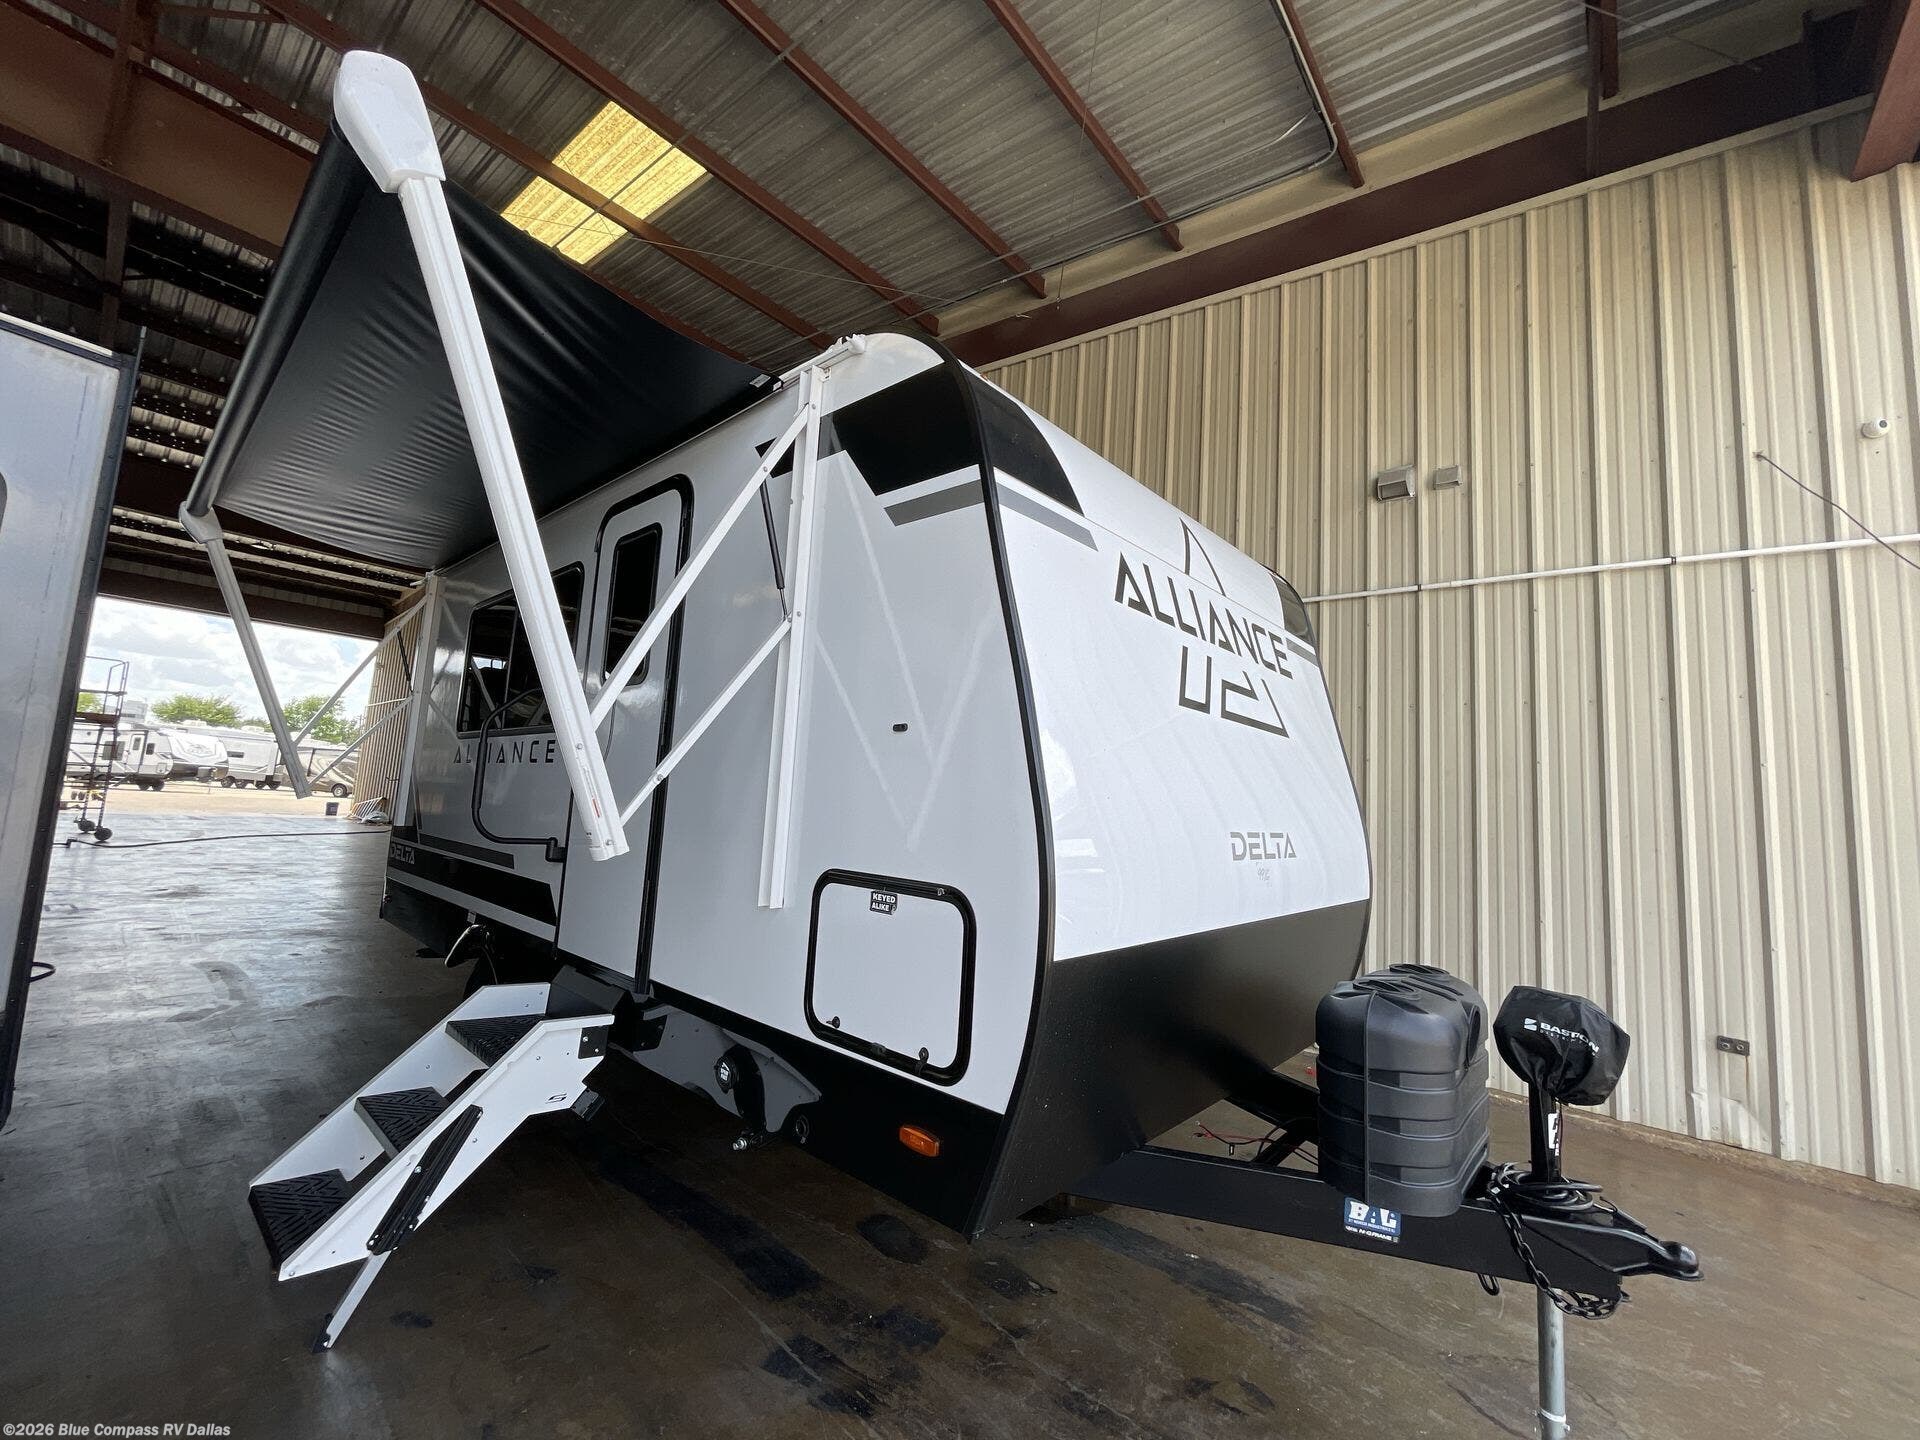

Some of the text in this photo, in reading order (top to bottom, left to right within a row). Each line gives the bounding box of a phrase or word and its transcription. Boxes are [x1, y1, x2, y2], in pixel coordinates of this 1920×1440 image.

[1114, 551, 1293, 680] ALLIANCE
[453, 740, 556, 763] ALIANCE
[390, 842, 415, 865] DELTA
[1230, 832, 1296, 861] DELTA
[871, 902, 890, 911] ALIKE
[872, 892, 896, 903] KEYED
